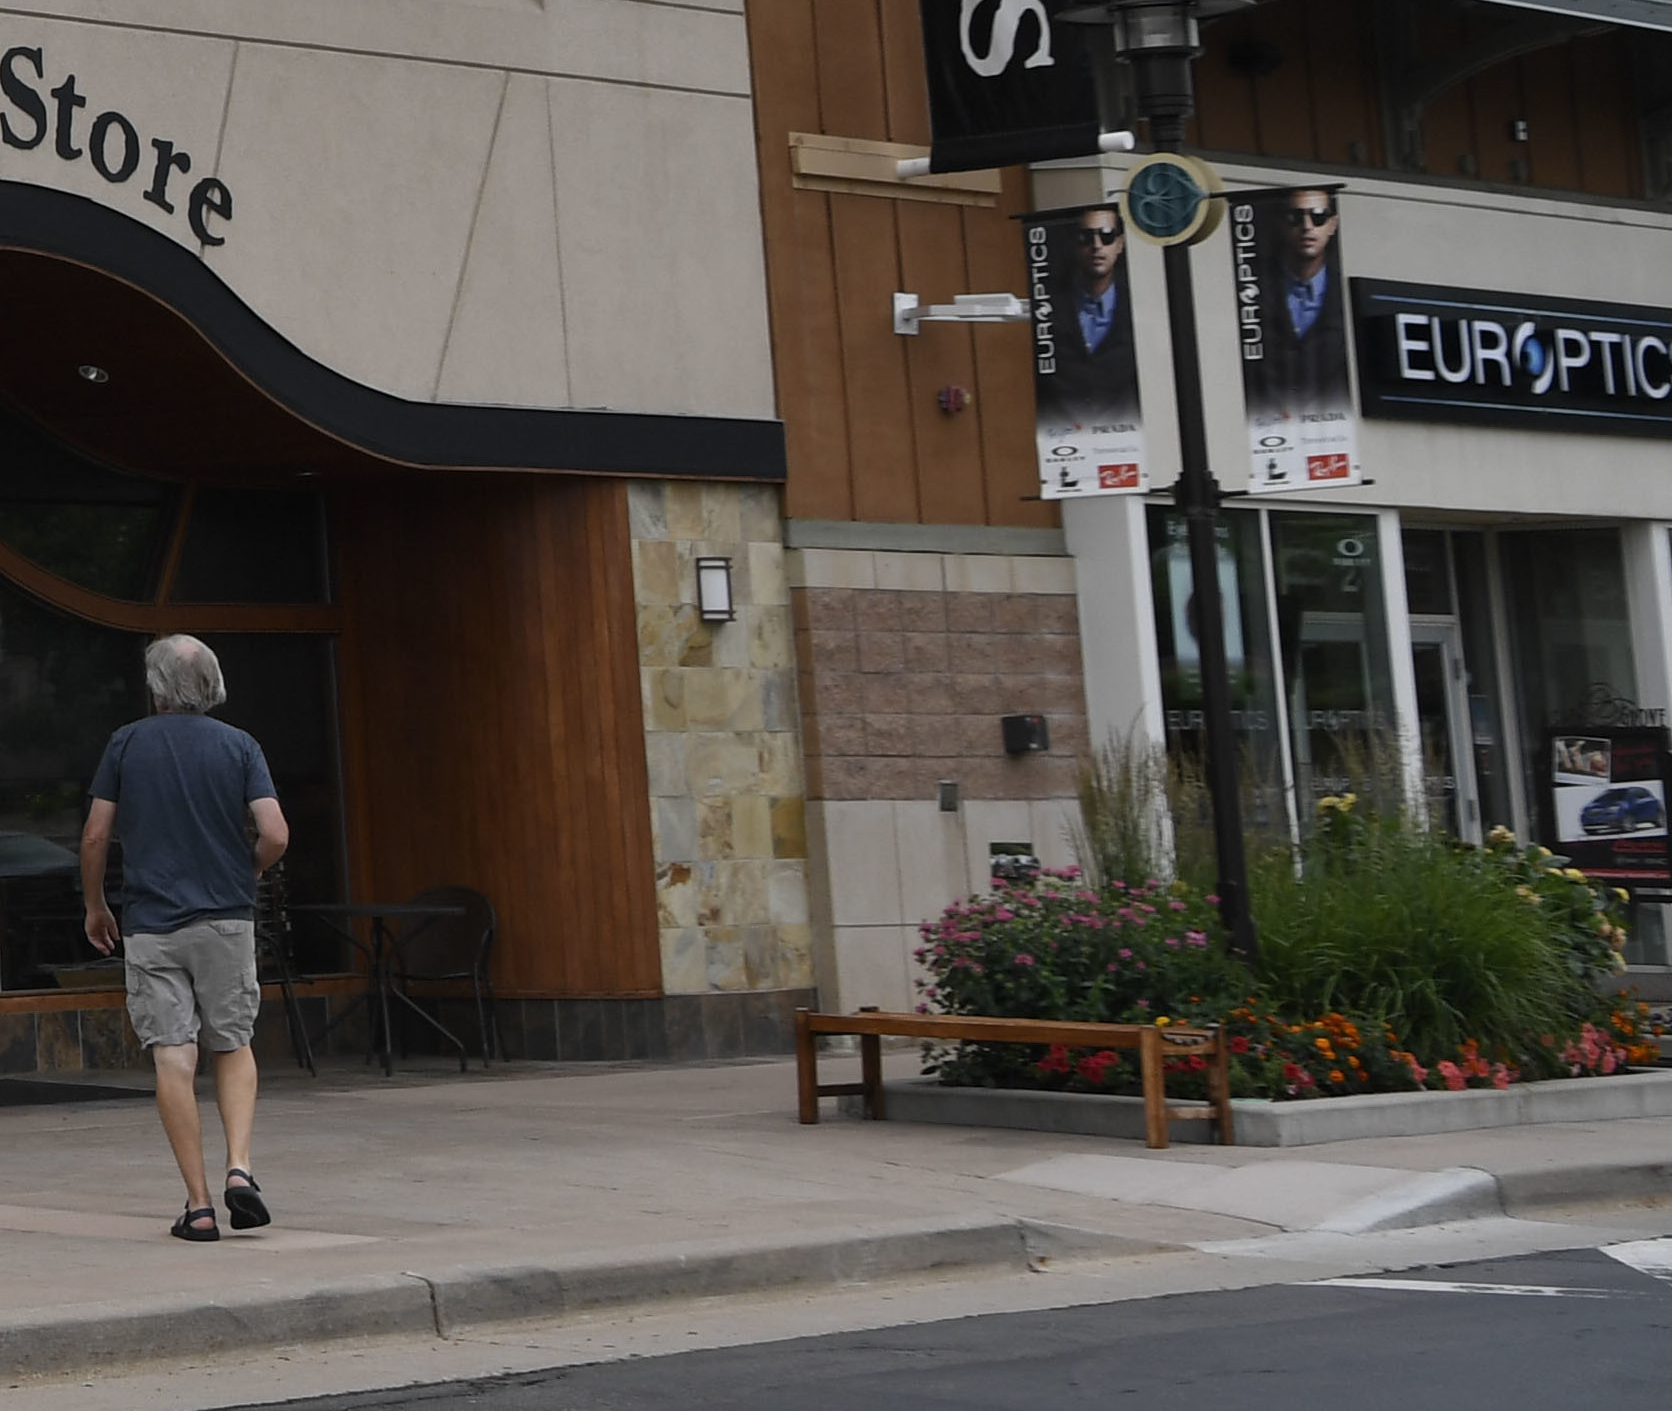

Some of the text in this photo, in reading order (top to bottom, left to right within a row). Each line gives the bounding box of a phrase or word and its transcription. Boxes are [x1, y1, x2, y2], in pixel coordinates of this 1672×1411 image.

[0, 46, 233, 246] Store
[1029, 227, 1056, 374] EUROPTICS
[1234, 204, 1263, 360] EUROPTICS
[1395, 313, 1672, 399] EUROPTIC
